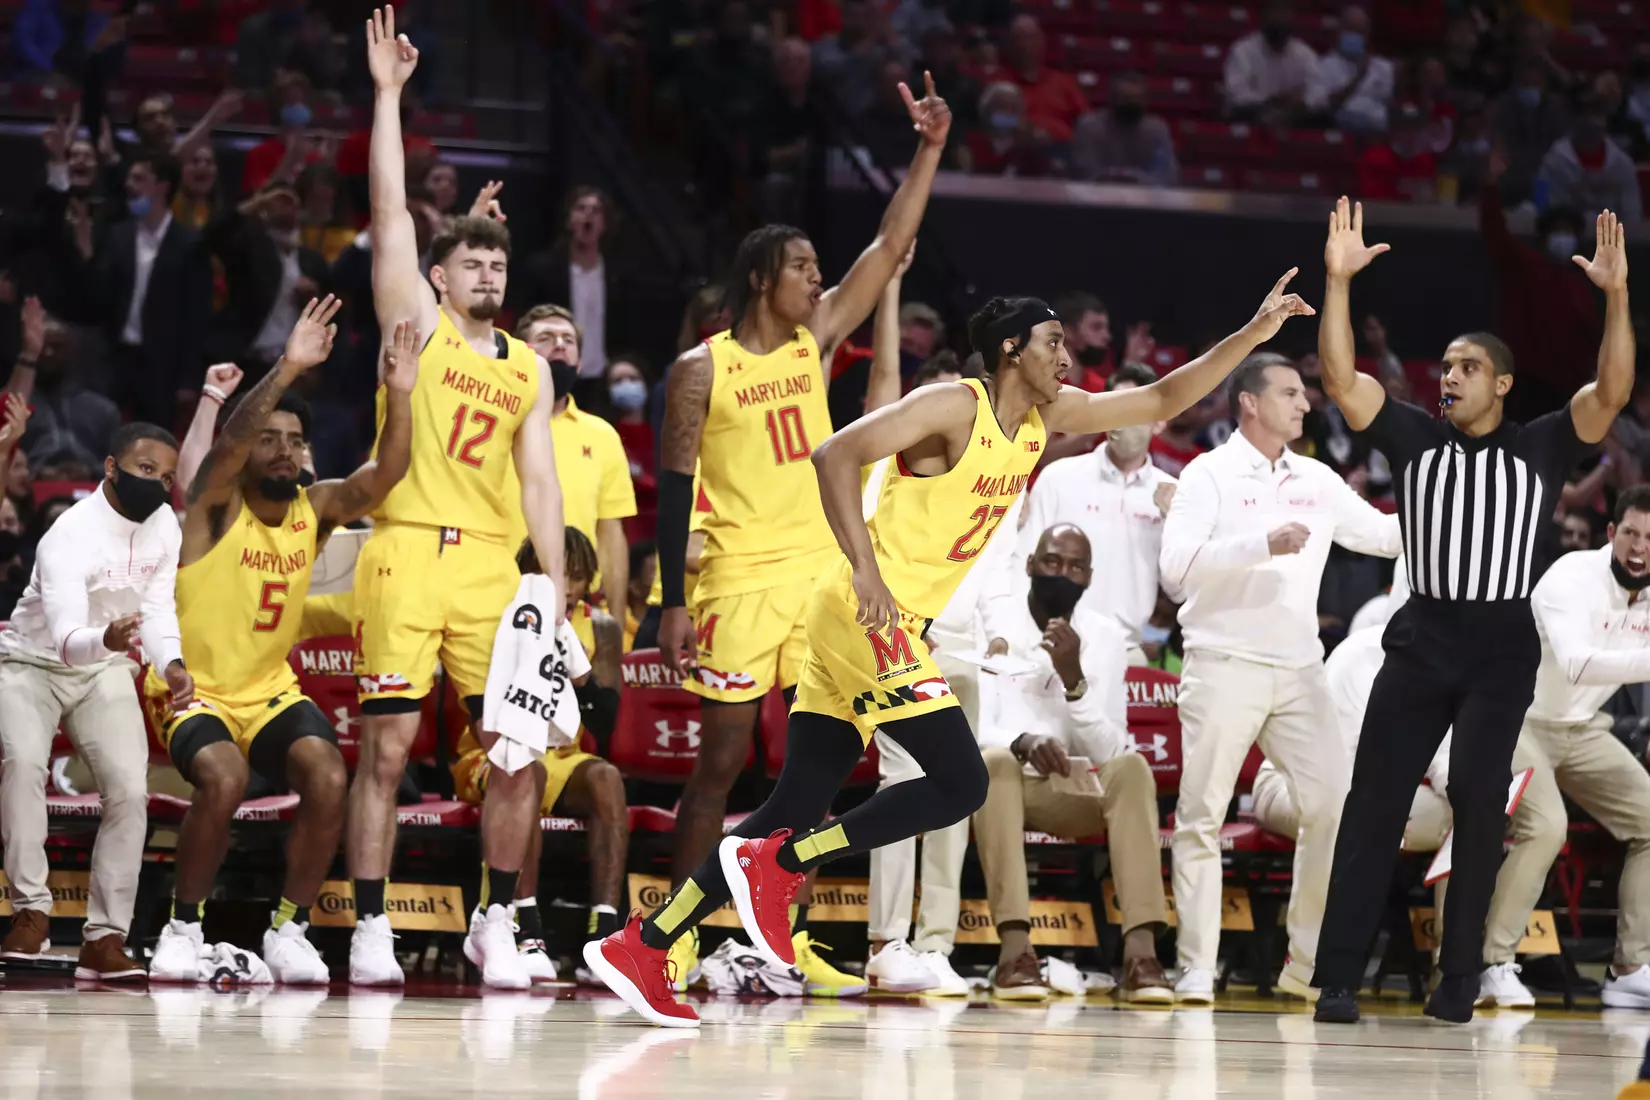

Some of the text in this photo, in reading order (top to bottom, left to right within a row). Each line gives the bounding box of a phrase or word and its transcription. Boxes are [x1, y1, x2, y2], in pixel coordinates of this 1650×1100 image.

[442, 367, 521, 415] MARYLAND
[735, 374, 811, 408] MARYLAND
[446, 403, 499, 470] 12
[765, 404, 811, 466] 10
[240, 548, 306, 576] MARYLAND
[252, 580, 289, 632] 5
[865, 627, 919, 675] M
[317, 892, 436, 914] Conental
[959, 910, 1067, 931] Conntal
